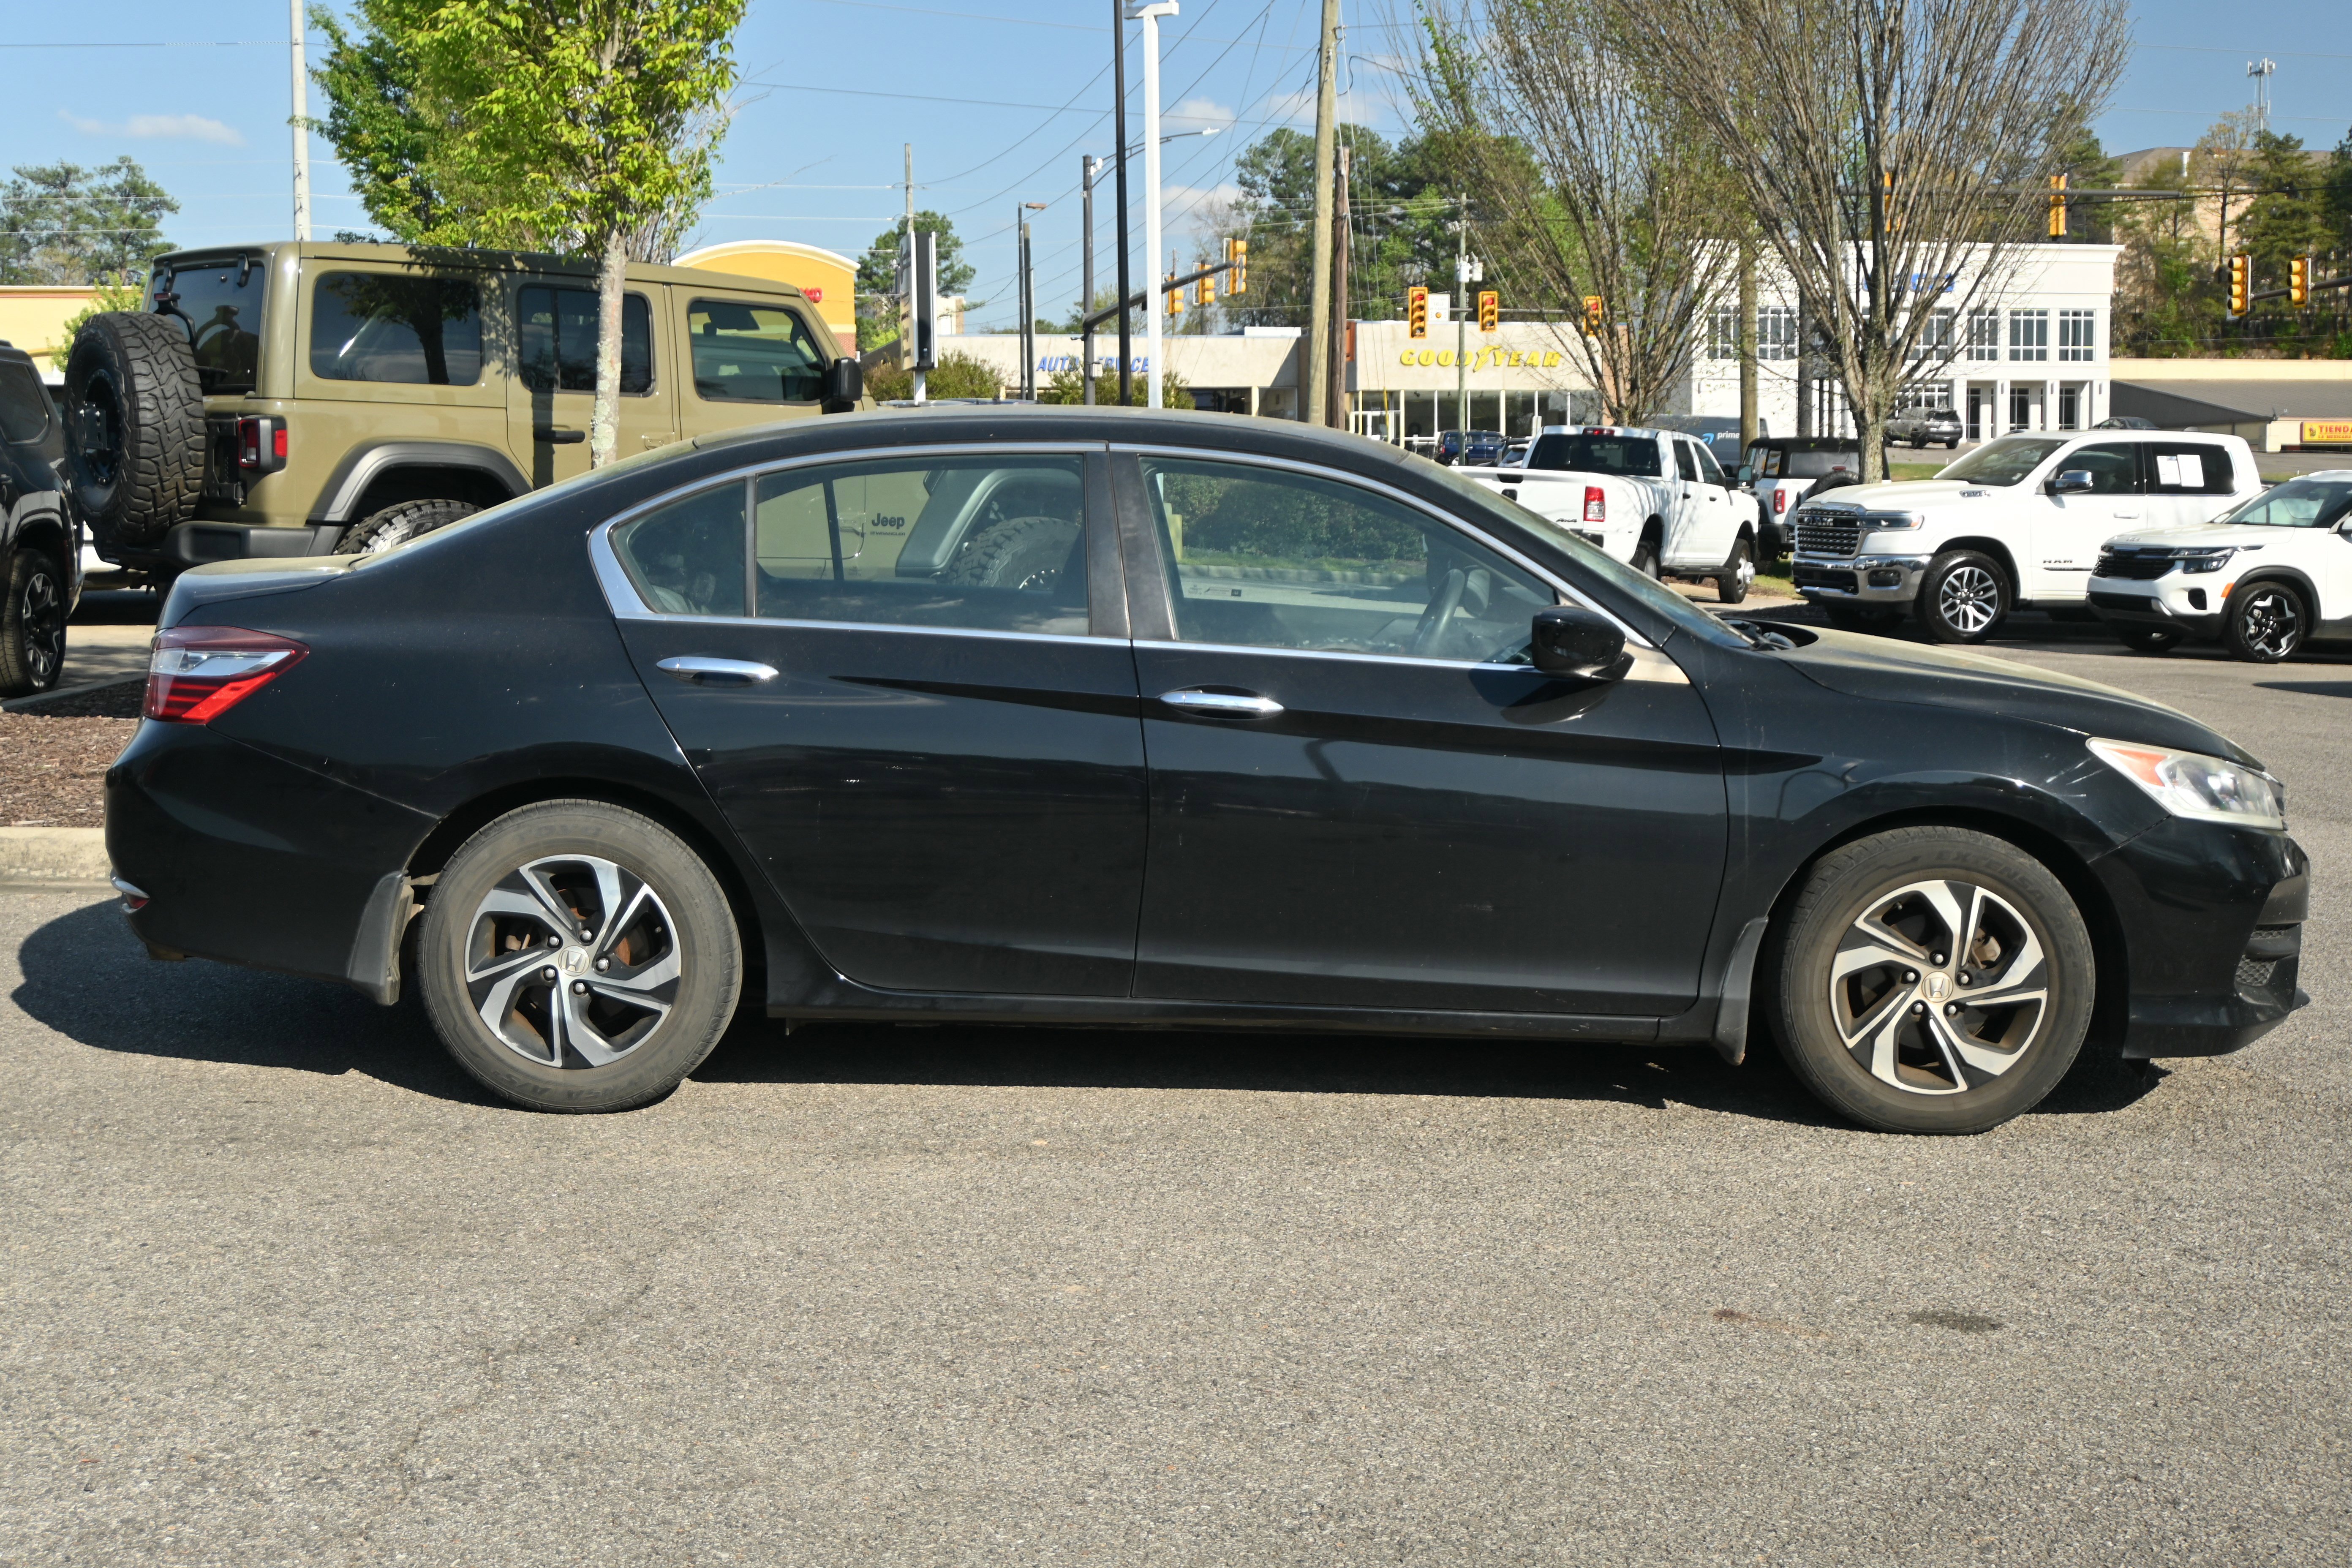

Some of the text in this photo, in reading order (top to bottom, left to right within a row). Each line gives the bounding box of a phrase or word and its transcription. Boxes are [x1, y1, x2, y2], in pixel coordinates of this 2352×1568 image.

[1036, 356, 1080, 372] AUTO
[1400, 349, 1562, 367] GOODYEAR
[1717, 430, 1740, 440] prime
[871, 512, 905, 530] Jeep
